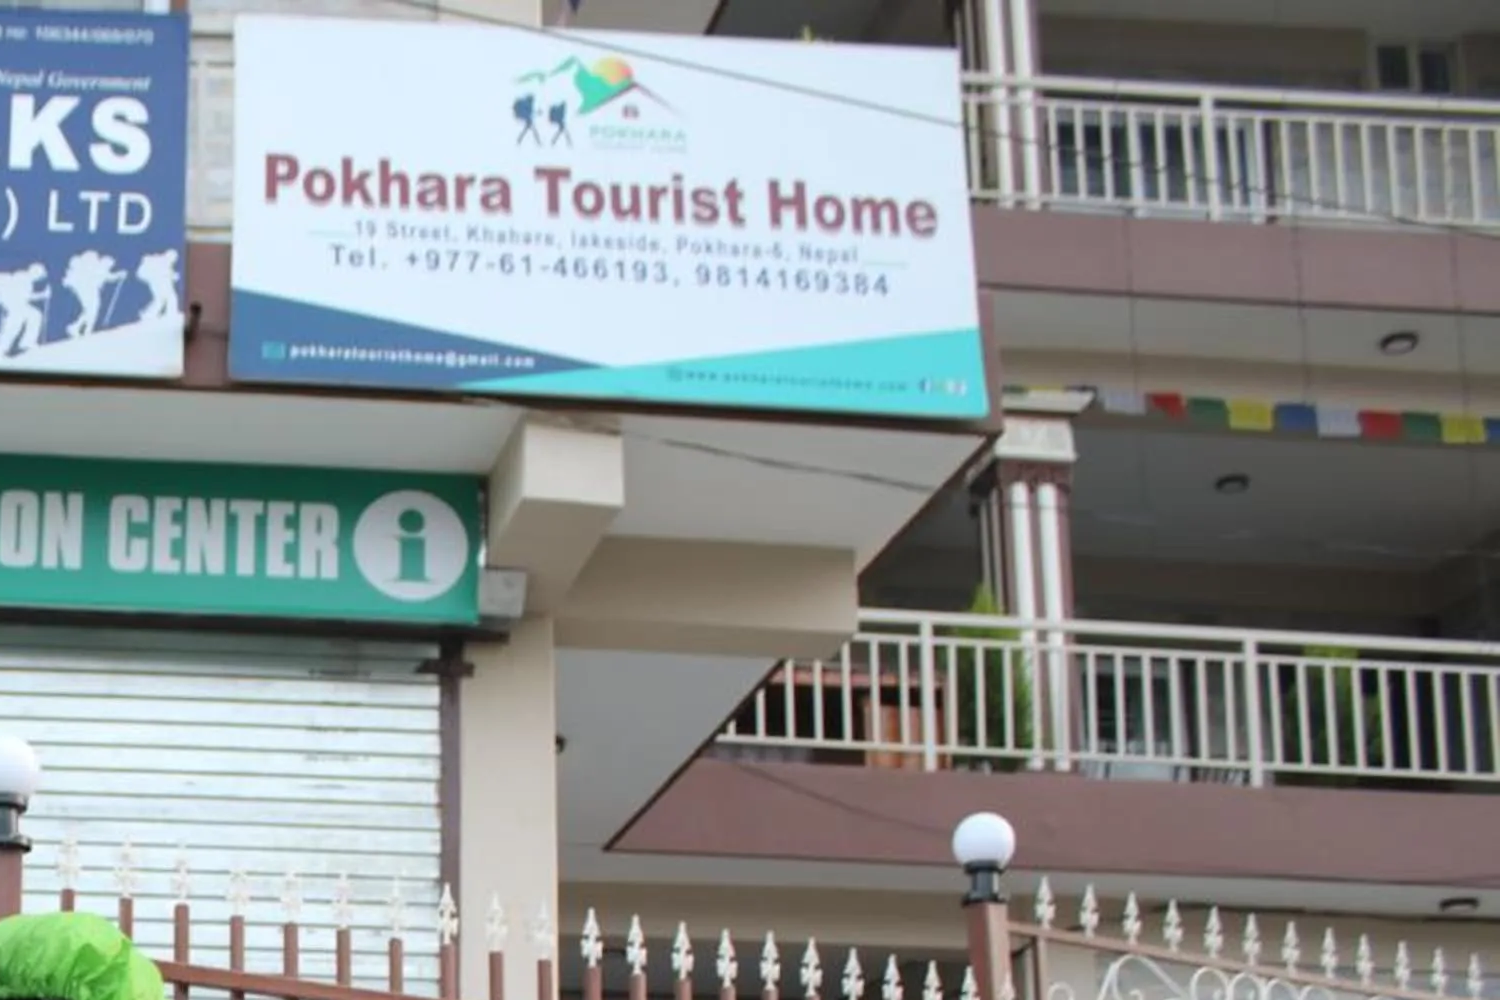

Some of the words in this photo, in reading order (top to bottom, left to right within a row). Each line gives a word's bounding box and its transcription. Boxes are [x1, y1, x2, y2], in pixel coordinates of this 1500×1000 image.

[47, 190, 153, 235] LTD
[263, 152, 513, 215] Pokhara
[533, 166, 746, 229] Tourist
[767, 178, 939, 240] Home
[329, 243, 389, 271] Tel.
[799, 241, 859, 266] Nepal
[107, 491, 342, 580] CENTER
